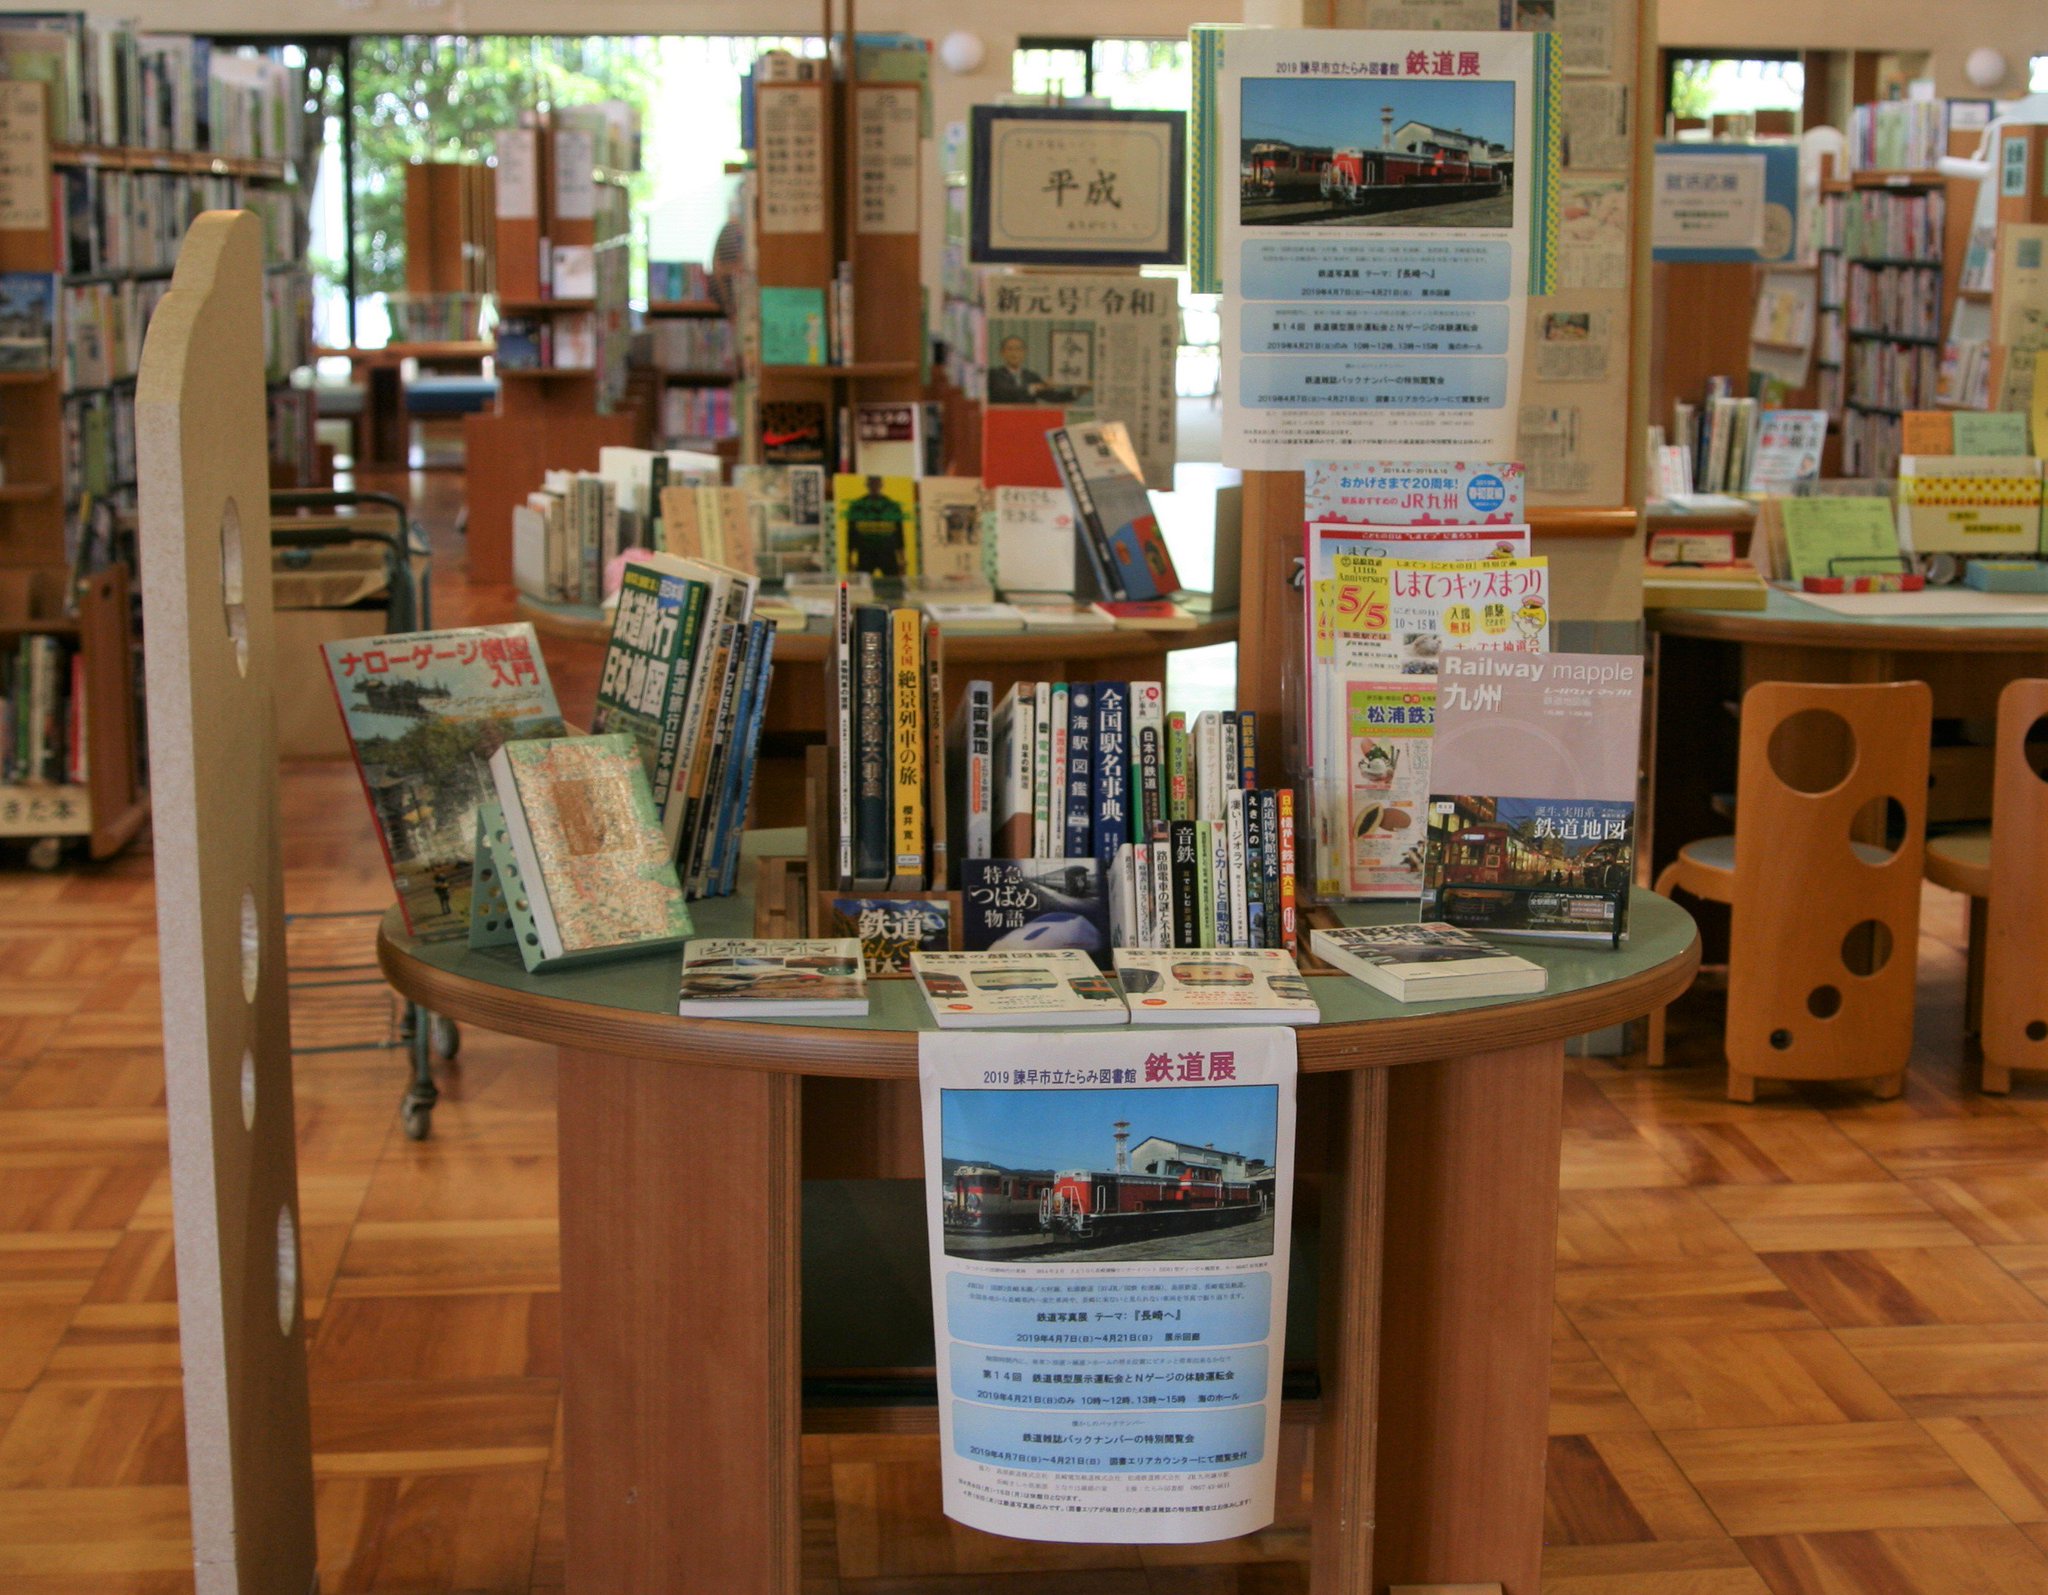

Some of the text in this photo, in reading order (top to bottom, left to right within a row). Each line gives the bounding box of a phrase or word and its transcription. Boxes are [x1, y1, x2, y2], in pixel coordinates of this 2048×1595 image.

[1405, 50, 1481, 76] 鉄道展
[1041, 168, 1122, 208] 平成
[1340, 573, 1388, 585] Anniversary
[1394, 568, 1542, 600] しまてつキッズまつり
[1337, 585, 1388, 629] 5/5
[1445, 656, 1634, 685] Railway mapple
[1443, 682, 1503, 713] 九州
[898, 669, 918, 786] 絶景列車の旅
[973, 690, 989, 755] 車両基地
[1071, 715, 1089, 797] 海駅図鑑
[1100, 688, 1124, 823] 全国駅名事典
[1143, 730, 1157, 790] 日本の鉄道
[1248, 797, 1259, 845] えきたの
[1533, 817, 1628, 841] 鉄道地図
[1176, 826, 1195, 864] 音鉄
[983, 864, 1024, 884] 特急
[858, 908, 926, 941] 鉄道
[985, 909, 1024, 929] 物語
[983, 1051, 1237, 1085] 2019 諫早市立たらみ図書館 鉄道展
[1036, 1311, 1088, 1323] 鉄道写真展
[1165, 1332, 1201, 1342] 展示回廊
[1022, 1433, 1195, 1445] 鉄道雑誌バックナンバーの特別閲覧会
